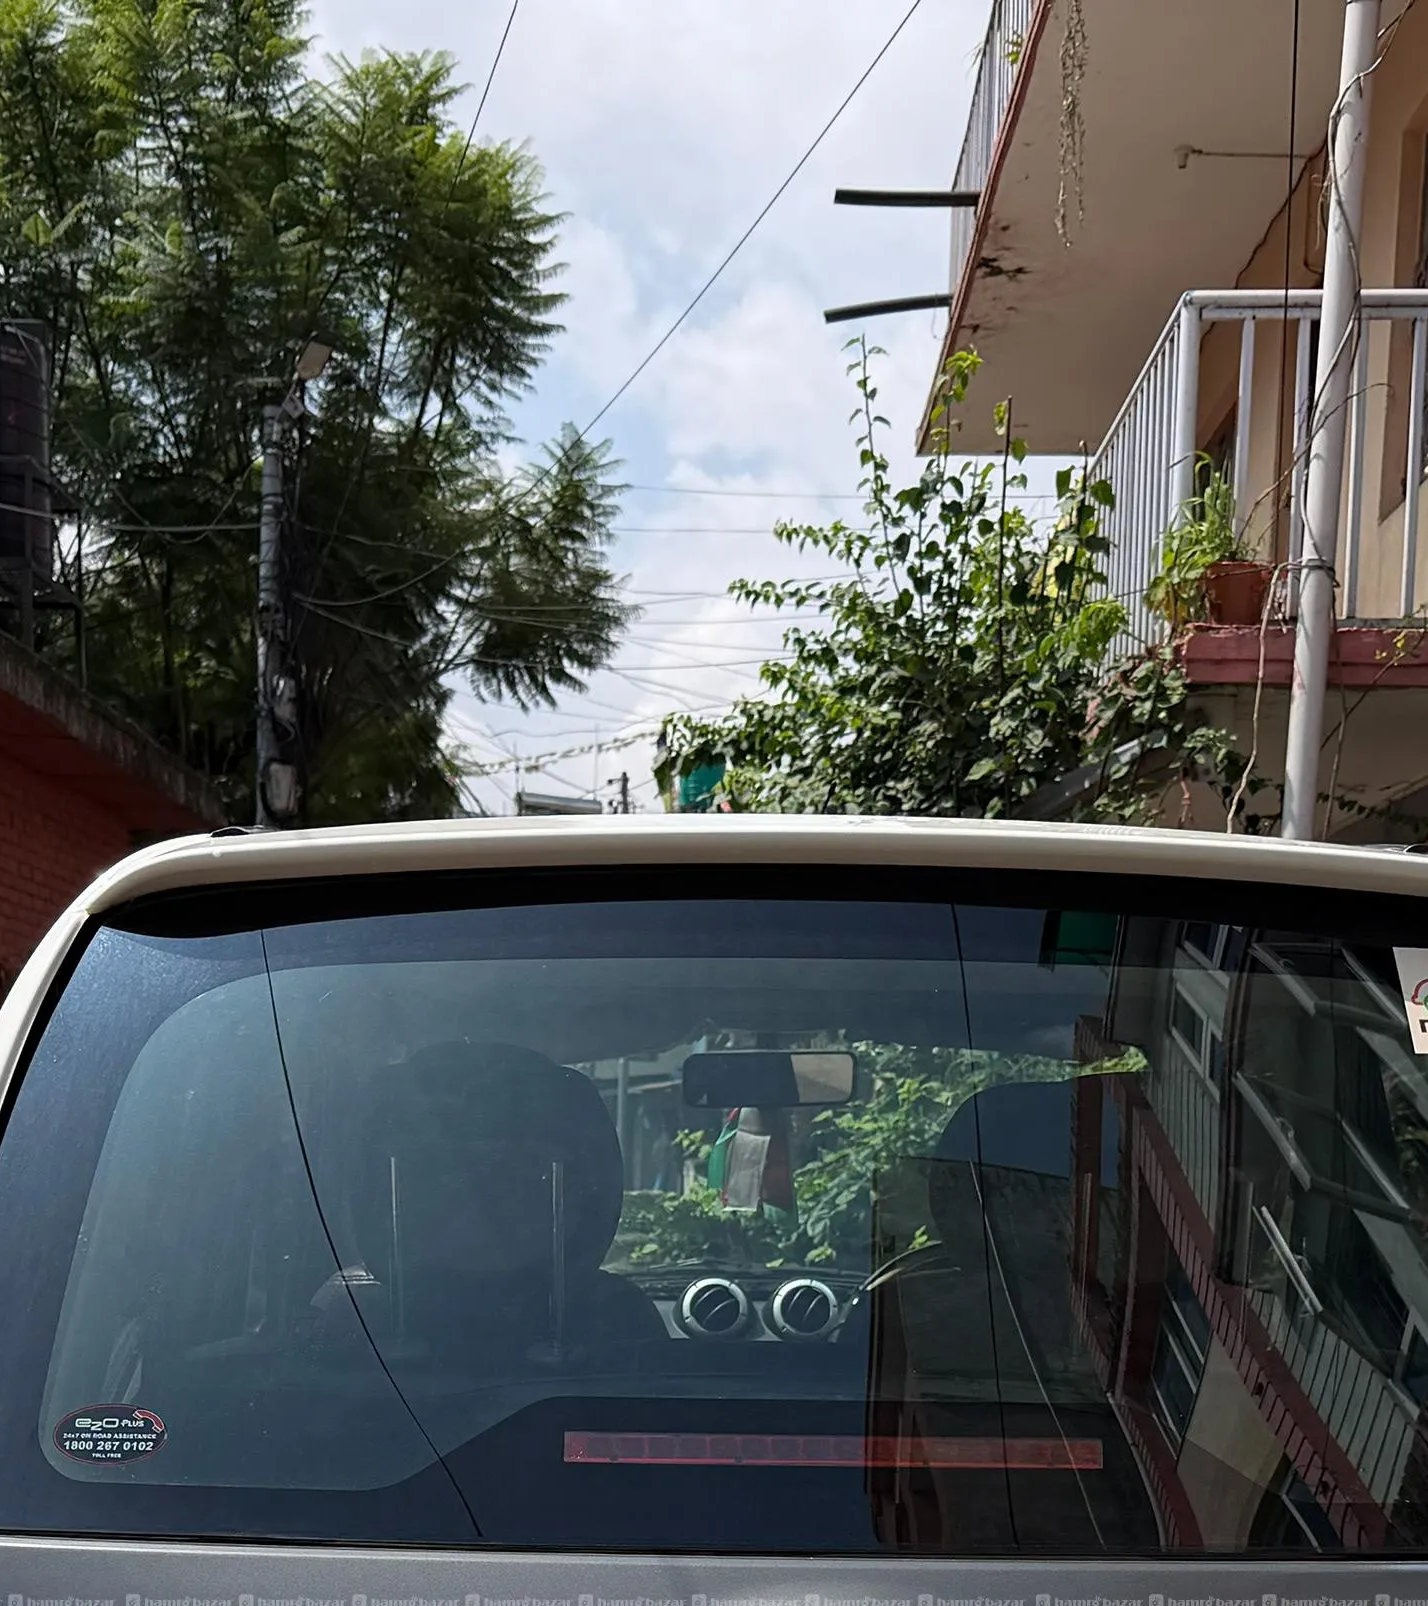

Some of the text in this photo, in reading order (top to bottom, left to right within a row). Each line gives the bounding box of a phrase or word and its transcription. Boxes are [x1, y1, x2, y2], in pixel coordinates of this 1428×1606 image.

[113, 1433, 158, 1441] ASSISTANCE
[63, 1440, 155, 1452] 1800 267 0102
